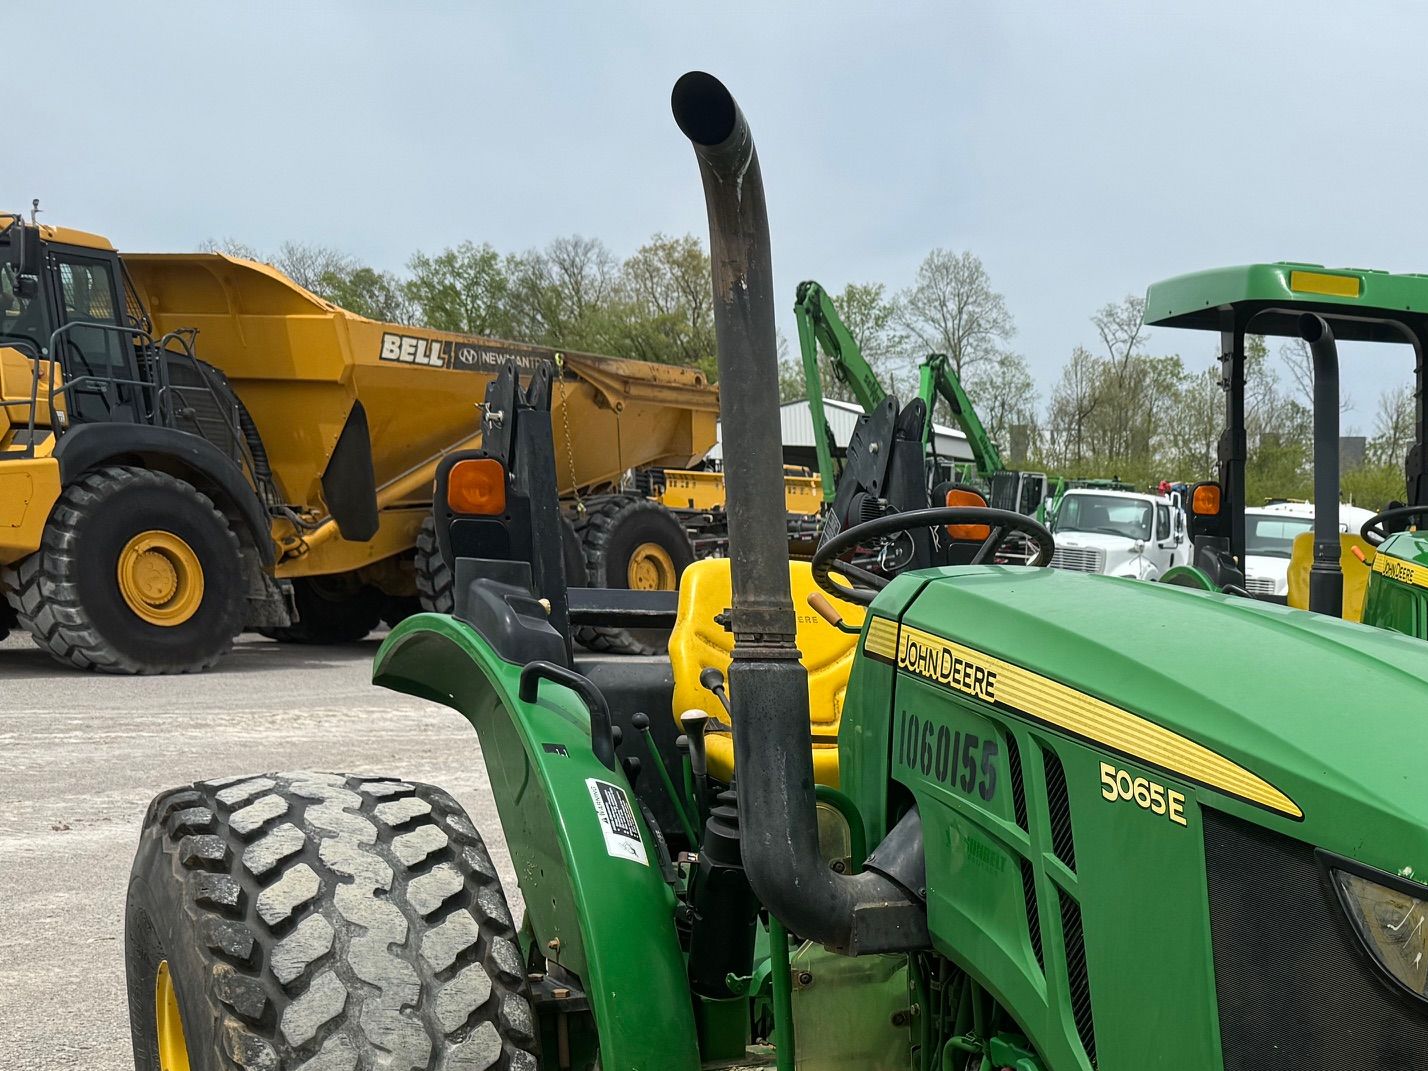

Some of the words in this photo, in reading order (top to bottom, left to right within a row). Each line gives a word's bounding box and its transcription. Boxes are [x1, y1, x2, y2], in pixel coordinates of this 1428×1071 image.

[381, 333, 445, 367] BELL
[1395, 562, 1415, 582] DEERE
[899, 634, 939, 677] JOHN
[939, 646, 998, 699] DEERE
[898, 709, 999, 802] 1060155
[1099, 760, 1188, 828] 5065E
